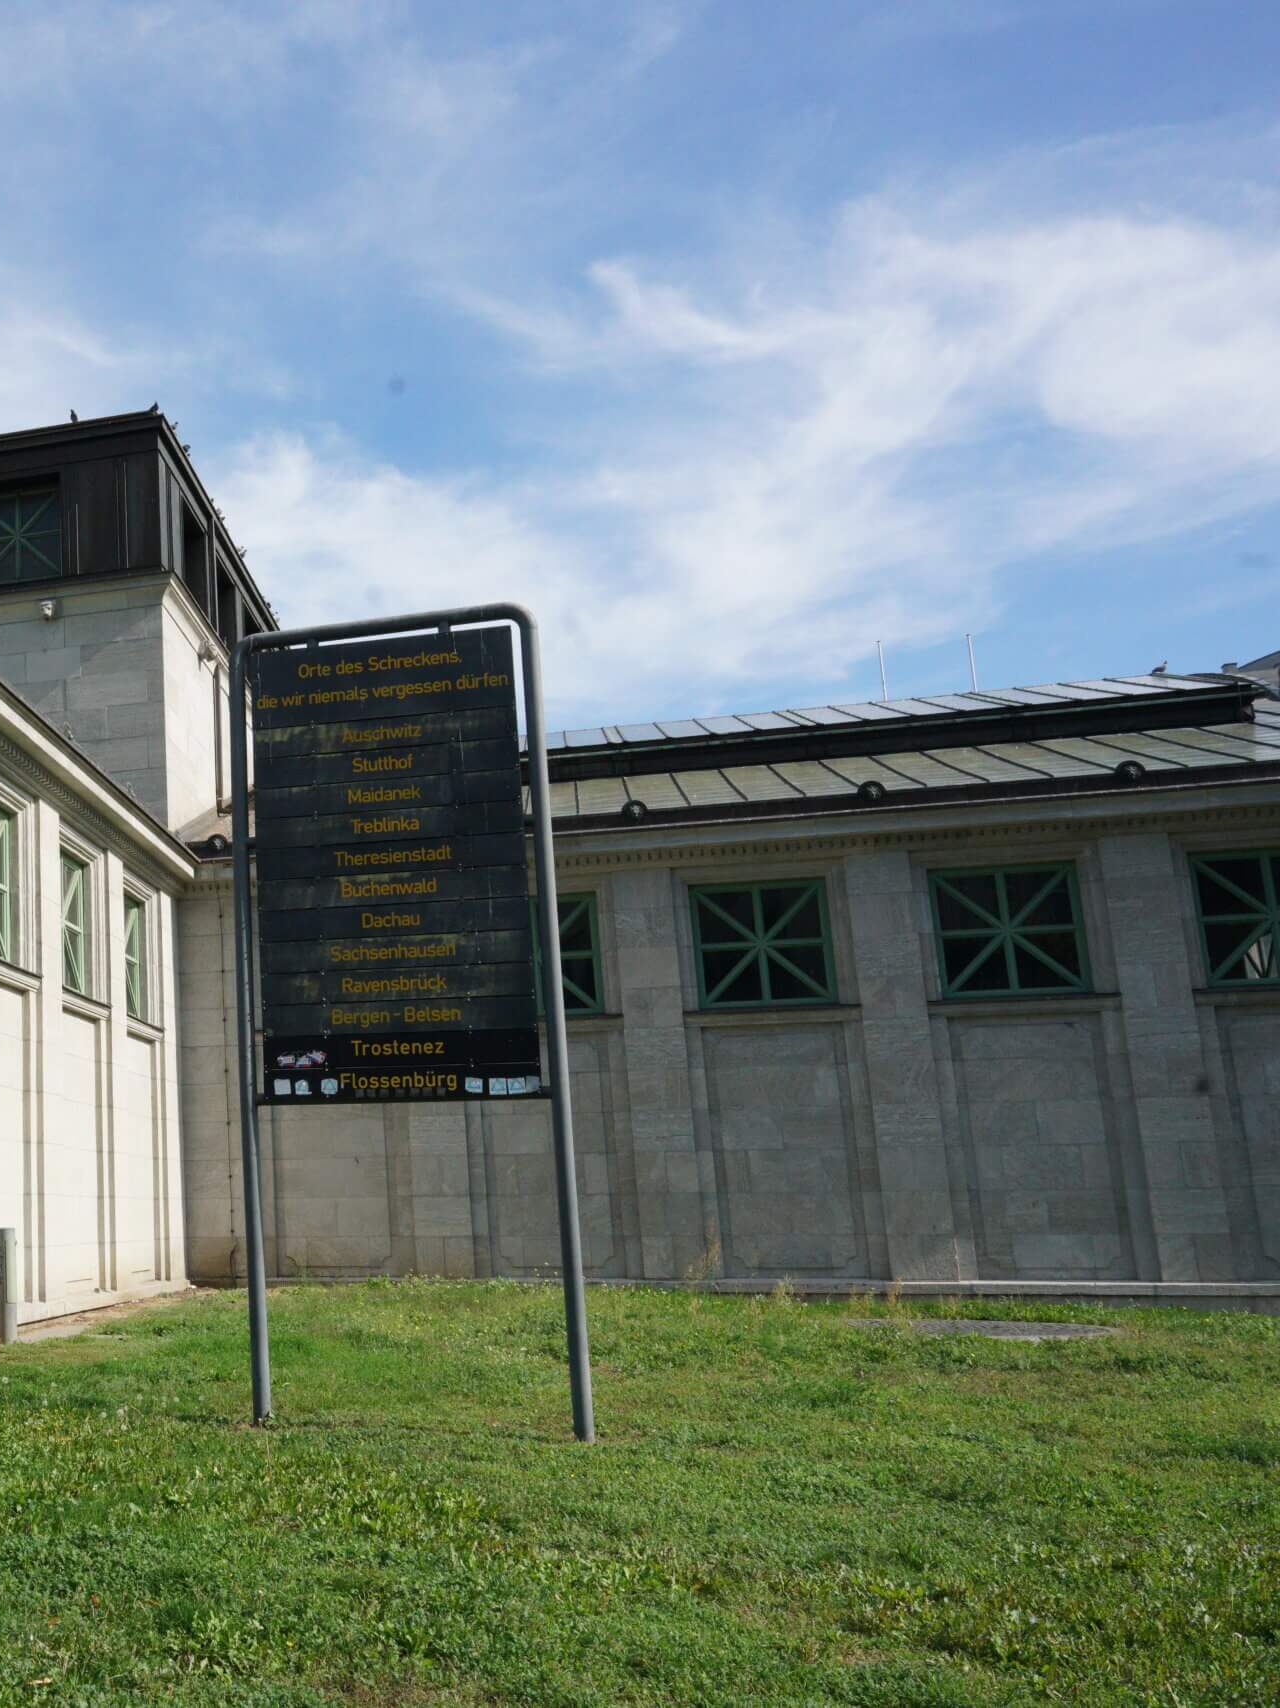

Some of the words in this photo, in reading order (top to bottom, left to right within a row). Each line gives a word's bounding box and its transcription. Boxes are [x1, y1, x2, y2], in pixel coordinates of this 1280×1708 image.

[298, 663, 331, 679] Orte
[335, 659, 364, 675] des
[256, 695, 279, 709] die
[281, 692, 305, 706] wir
[308, 686, 369, 704] niemals
[372, 680, 452, 699] vergessen
[456, 672, 509, 690] dürfen
[342, 723, 422, 742] Auschwitz
[352, 754, 414, 773] Stutthof
[347, 784, 421, 804] Maidanek
[351, 817, 420, 834] Treblinka
[335, 846, 452, 866] Theresienstadt
[341, 879, 437, 898] Buchenwald
[361, 912, 420, 929] Dachau
[330, 943, 456, 962] Sachsenhausen
[342, 973, 447, 993] Ravensbrück
[351, 1039, 445, 1057] Trostenez
[340, 1070, 458, 1090] Flossenbürg
